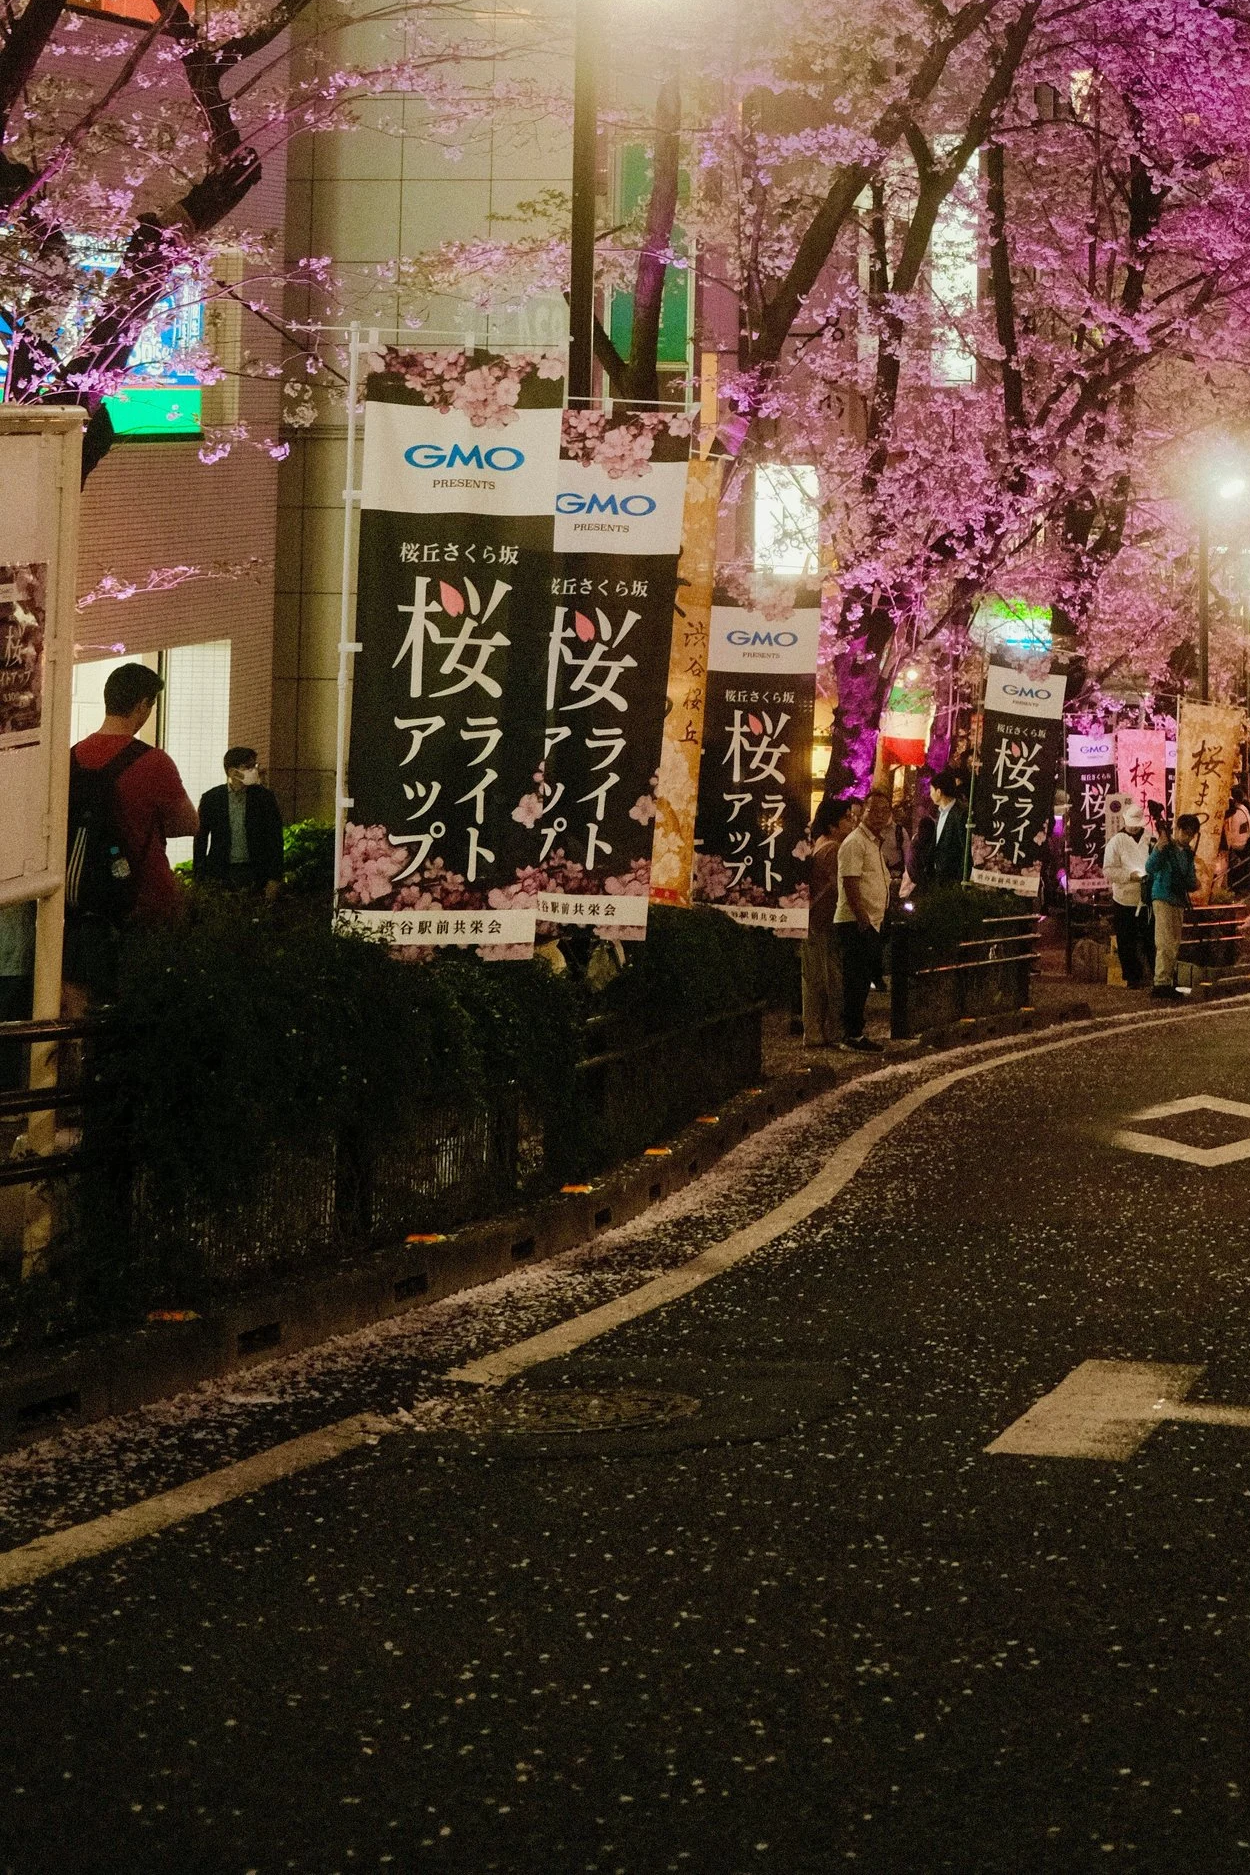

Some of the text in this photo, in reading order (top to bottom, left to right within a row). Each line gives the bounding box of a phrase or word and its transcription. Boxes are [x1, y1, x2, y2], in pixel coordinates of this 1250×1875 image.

[404, 443, 526, 472] GMO
[432, 478, 496, 491] PRESENTS
[555, 492, 657, 517] GMO
[573, 522, 630, 534] PRESENTS
[400, 541, 520, 566] 桜丘さくら坂
[726, 629, 799, 647] GMO
[742, 650, 781, 660] PRESENTS
[725, 689, 796, 705] 桜丘さくら坂
[1002, 683, 1052, 700] GMO
[1079, 744, 1109, 754] GMO
[388, 715, 447, 882] アップ
[454, 716, 504, 883] ライト
[577, 727, 627, 871] ライト
[985, 793, 1010, 860] アップ
[1010, 797, 1034, 865] ライト
[722, 792, 754, 890] アップ
